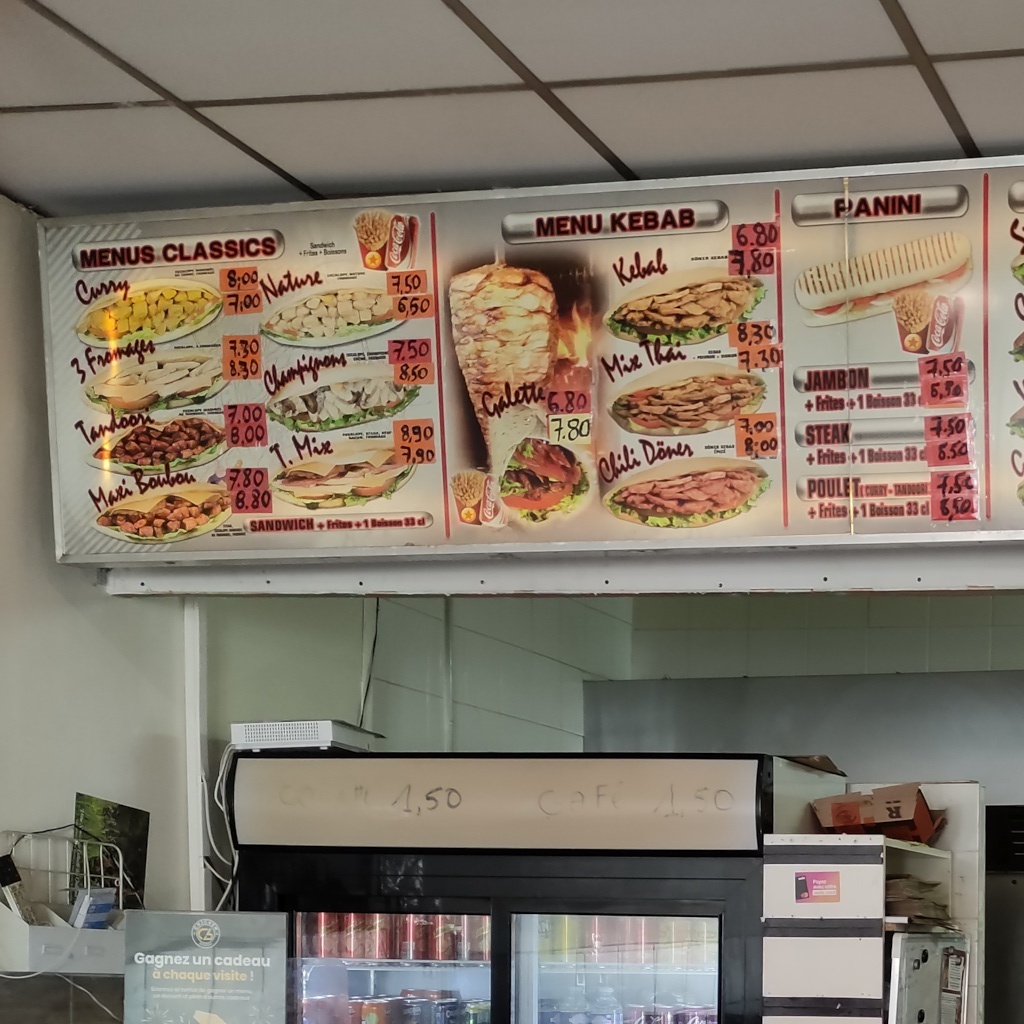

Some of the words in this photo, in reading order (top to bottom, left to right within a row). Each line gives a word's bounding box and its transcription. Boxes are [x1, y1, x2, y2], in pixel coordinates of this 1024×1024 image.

[834, 194, 922, 219] PANINI
[536, 213, 602, 238] MENU
[611, 208, 695, 233] KEBAB
[80, 245, 155, 269] MENUS
[162, 237, 276, 263] CLASSICS
[324, 248, 347, 256] Boissons
[612, 248, 668, 286] Kebab
[76, 280, 130, 304] Curry
[260, 270, 322, 304] Nature
[71, 358, 86, 384] 3
[85, 338, 156, 375] Fromages
[600, 353, 642, 382] Mix
[639, 338, 686, 366] Thai
[264, 352, 347, 396] Champignons
[804, 367, 869, 392] JAMBON
[482, 382, 546, 418] Galette
[816, 395, 845, 411] Frites
[866, 394, 902, 409] Boisson
[904, 392, 916, 406] 33
[74, 408, 154, 445] Tandoori
[805, 423, 851, 446] STEAK
[292, 434, 334, 460] Mix
[817, 449, 846, 464] Frites
[868, 448, 903, 462] Boisson
[905, 447, 917, 460] 33
[600, 445, 641, 483] Chili
[88, 479, 133, 512] Maxi
[808, 478, 861, 498] POULET
[819, 503, 847, 518] Frites
[870, 502, 906, 516] Boisson
[907, 502, 919, 515] 33
[920, 501, 929, 514] cl
[250, 518, 314, 532] SANDWICH
[326, 520, 352, 530] Frites
[371, 518, 402, 528] Boisson
[404, 518, 416, 526] 33
[134, 952, 190, 968] Gagnez
[192, 956, 211, 966] un
[214, 954, 270, 967] cadeau
[152, 968, 160, 980] à
[163, 969, 210, 983] chaque
[213, 970, 247, 981] visite
